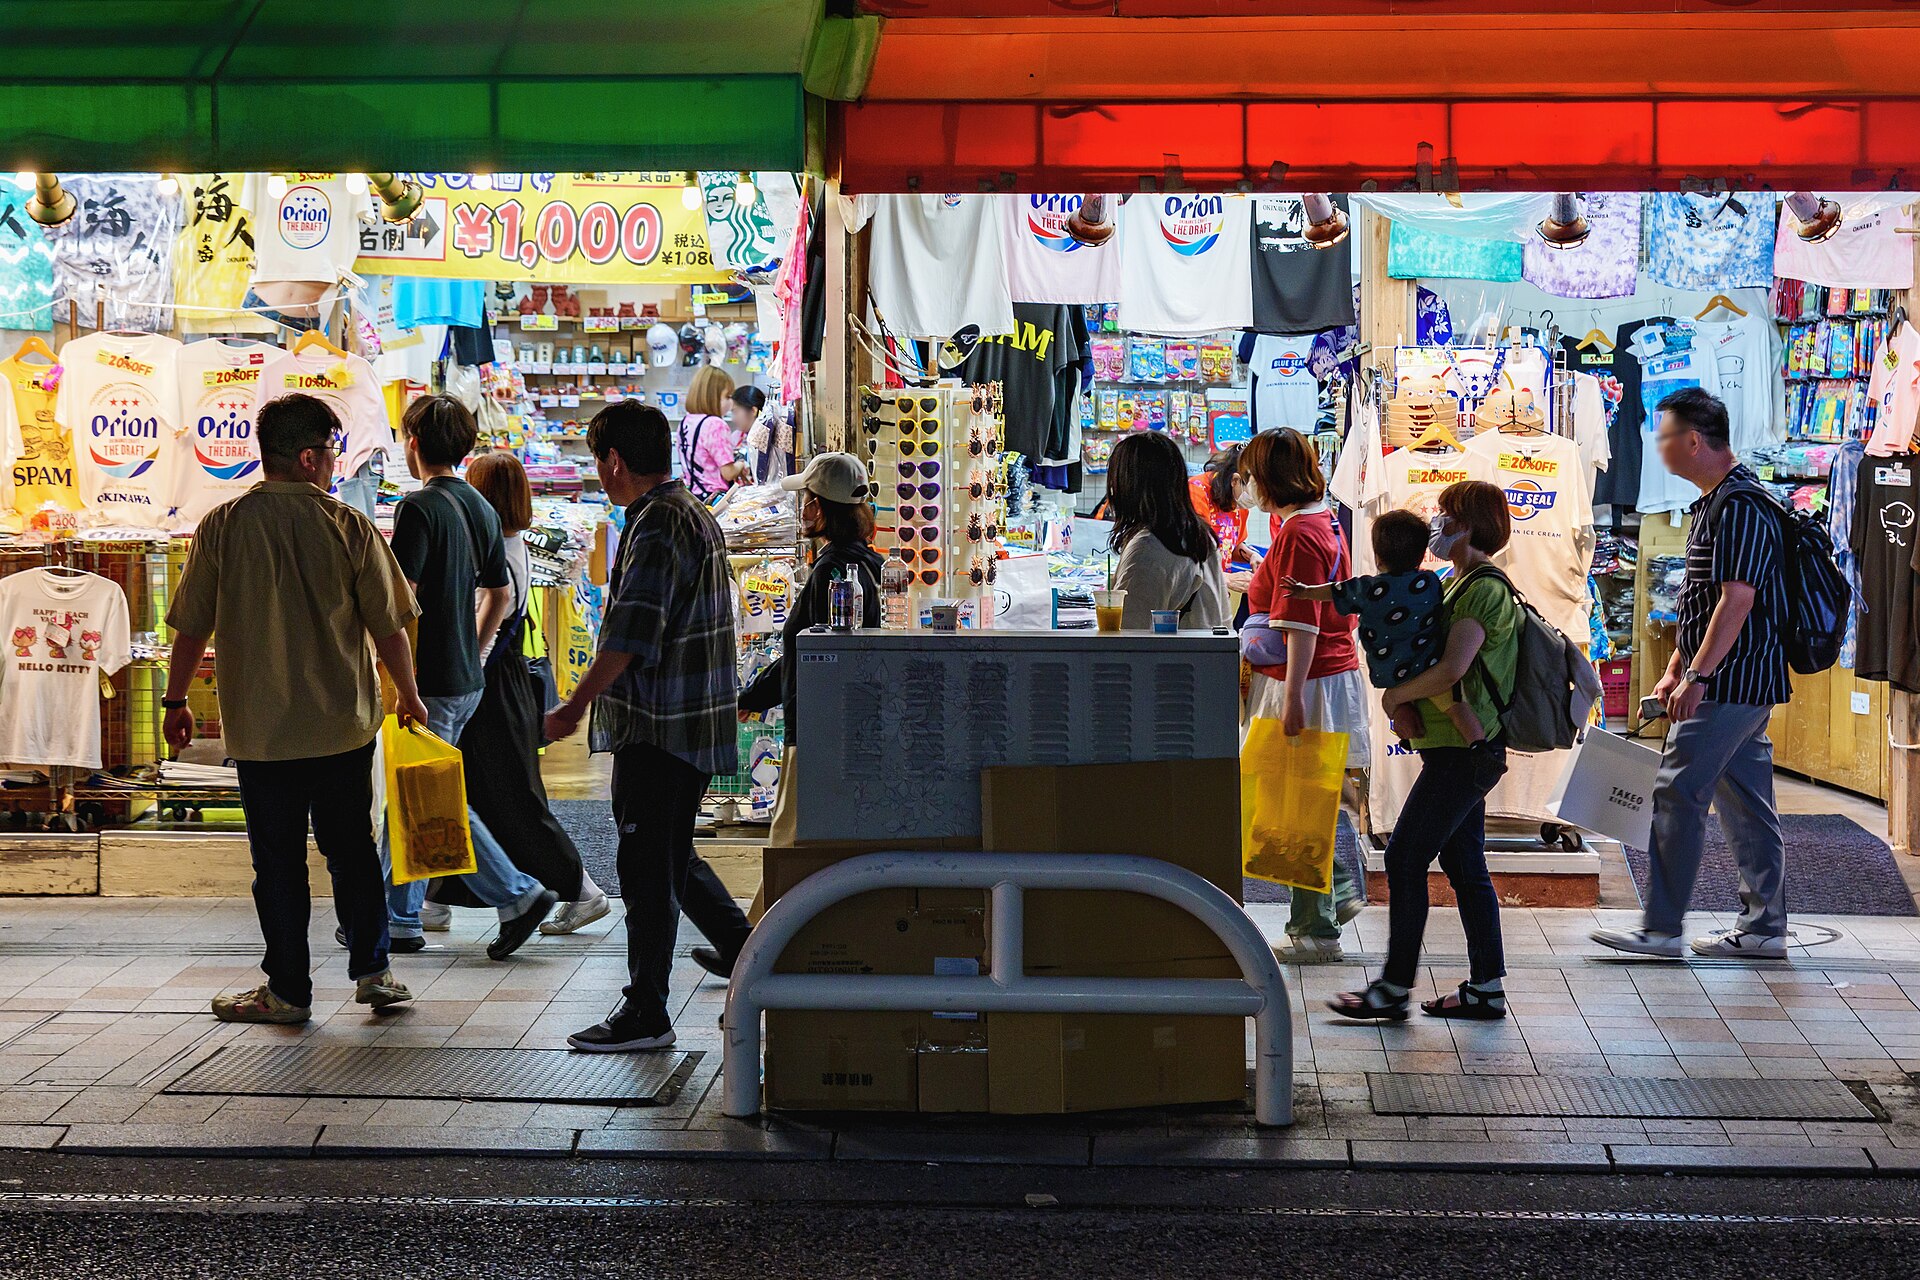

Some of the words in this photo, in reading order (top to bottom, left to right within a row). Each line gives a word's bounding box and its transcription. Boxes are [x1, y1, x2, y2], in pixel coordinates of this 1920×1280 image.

[283, 203, 327, 222] Orion
[1164, 194, 1223, 219] Orion
[287, 222, 299, 232] THE
[301, 222, 323, 232] DRAFT
[1042, 217, 1056, 229] THE
[1173, 223, 1187, 236] THE
[1189, 222, 1212, 235] DRAFT
[453, 198, 664, 270] ¥1,000
[674, 233, 705, 249] 税込
[108, 355, 153, 376] 20%OFF
[1274, 359, 1289, 368] BLUE
[1291, 358, 1306, 367] SEA
[216, 370, 260, 383] 20%OFF
[91, 409, 157, 438] Orion
[198, 412, 251, 438] Orio
[103, 445, 118, 456] THE
[121, 445, 145, 456] DRAFT
[208, 446, 223, 457] THE
[1511, 456, 1558, 473] 20%OFF
[13, 466, 72, 487] SPAM
[1421, 471, 1467, 483] 20%OFF
[97, 492, 151, 505] OKINAWA
[1507, 492, 1523, 504] LUE
[1525, 493, 1552, 506] SEAL
[1537, 531, 1562, 539] CREAM
[99, 542, 143, 552] 20%OFF
[756, 581, 784, 594] 10%OFF
[33, 608, 56, 616] HAPP
[68, 611, 89, 619] EACH
[19, 662, 54, 672] HELLO
[57, 664, 91, 674] KITTY
[1611, 786, 1644, 805] TAKEO
[1608, 795, 1640, 812] KIKUCHI
